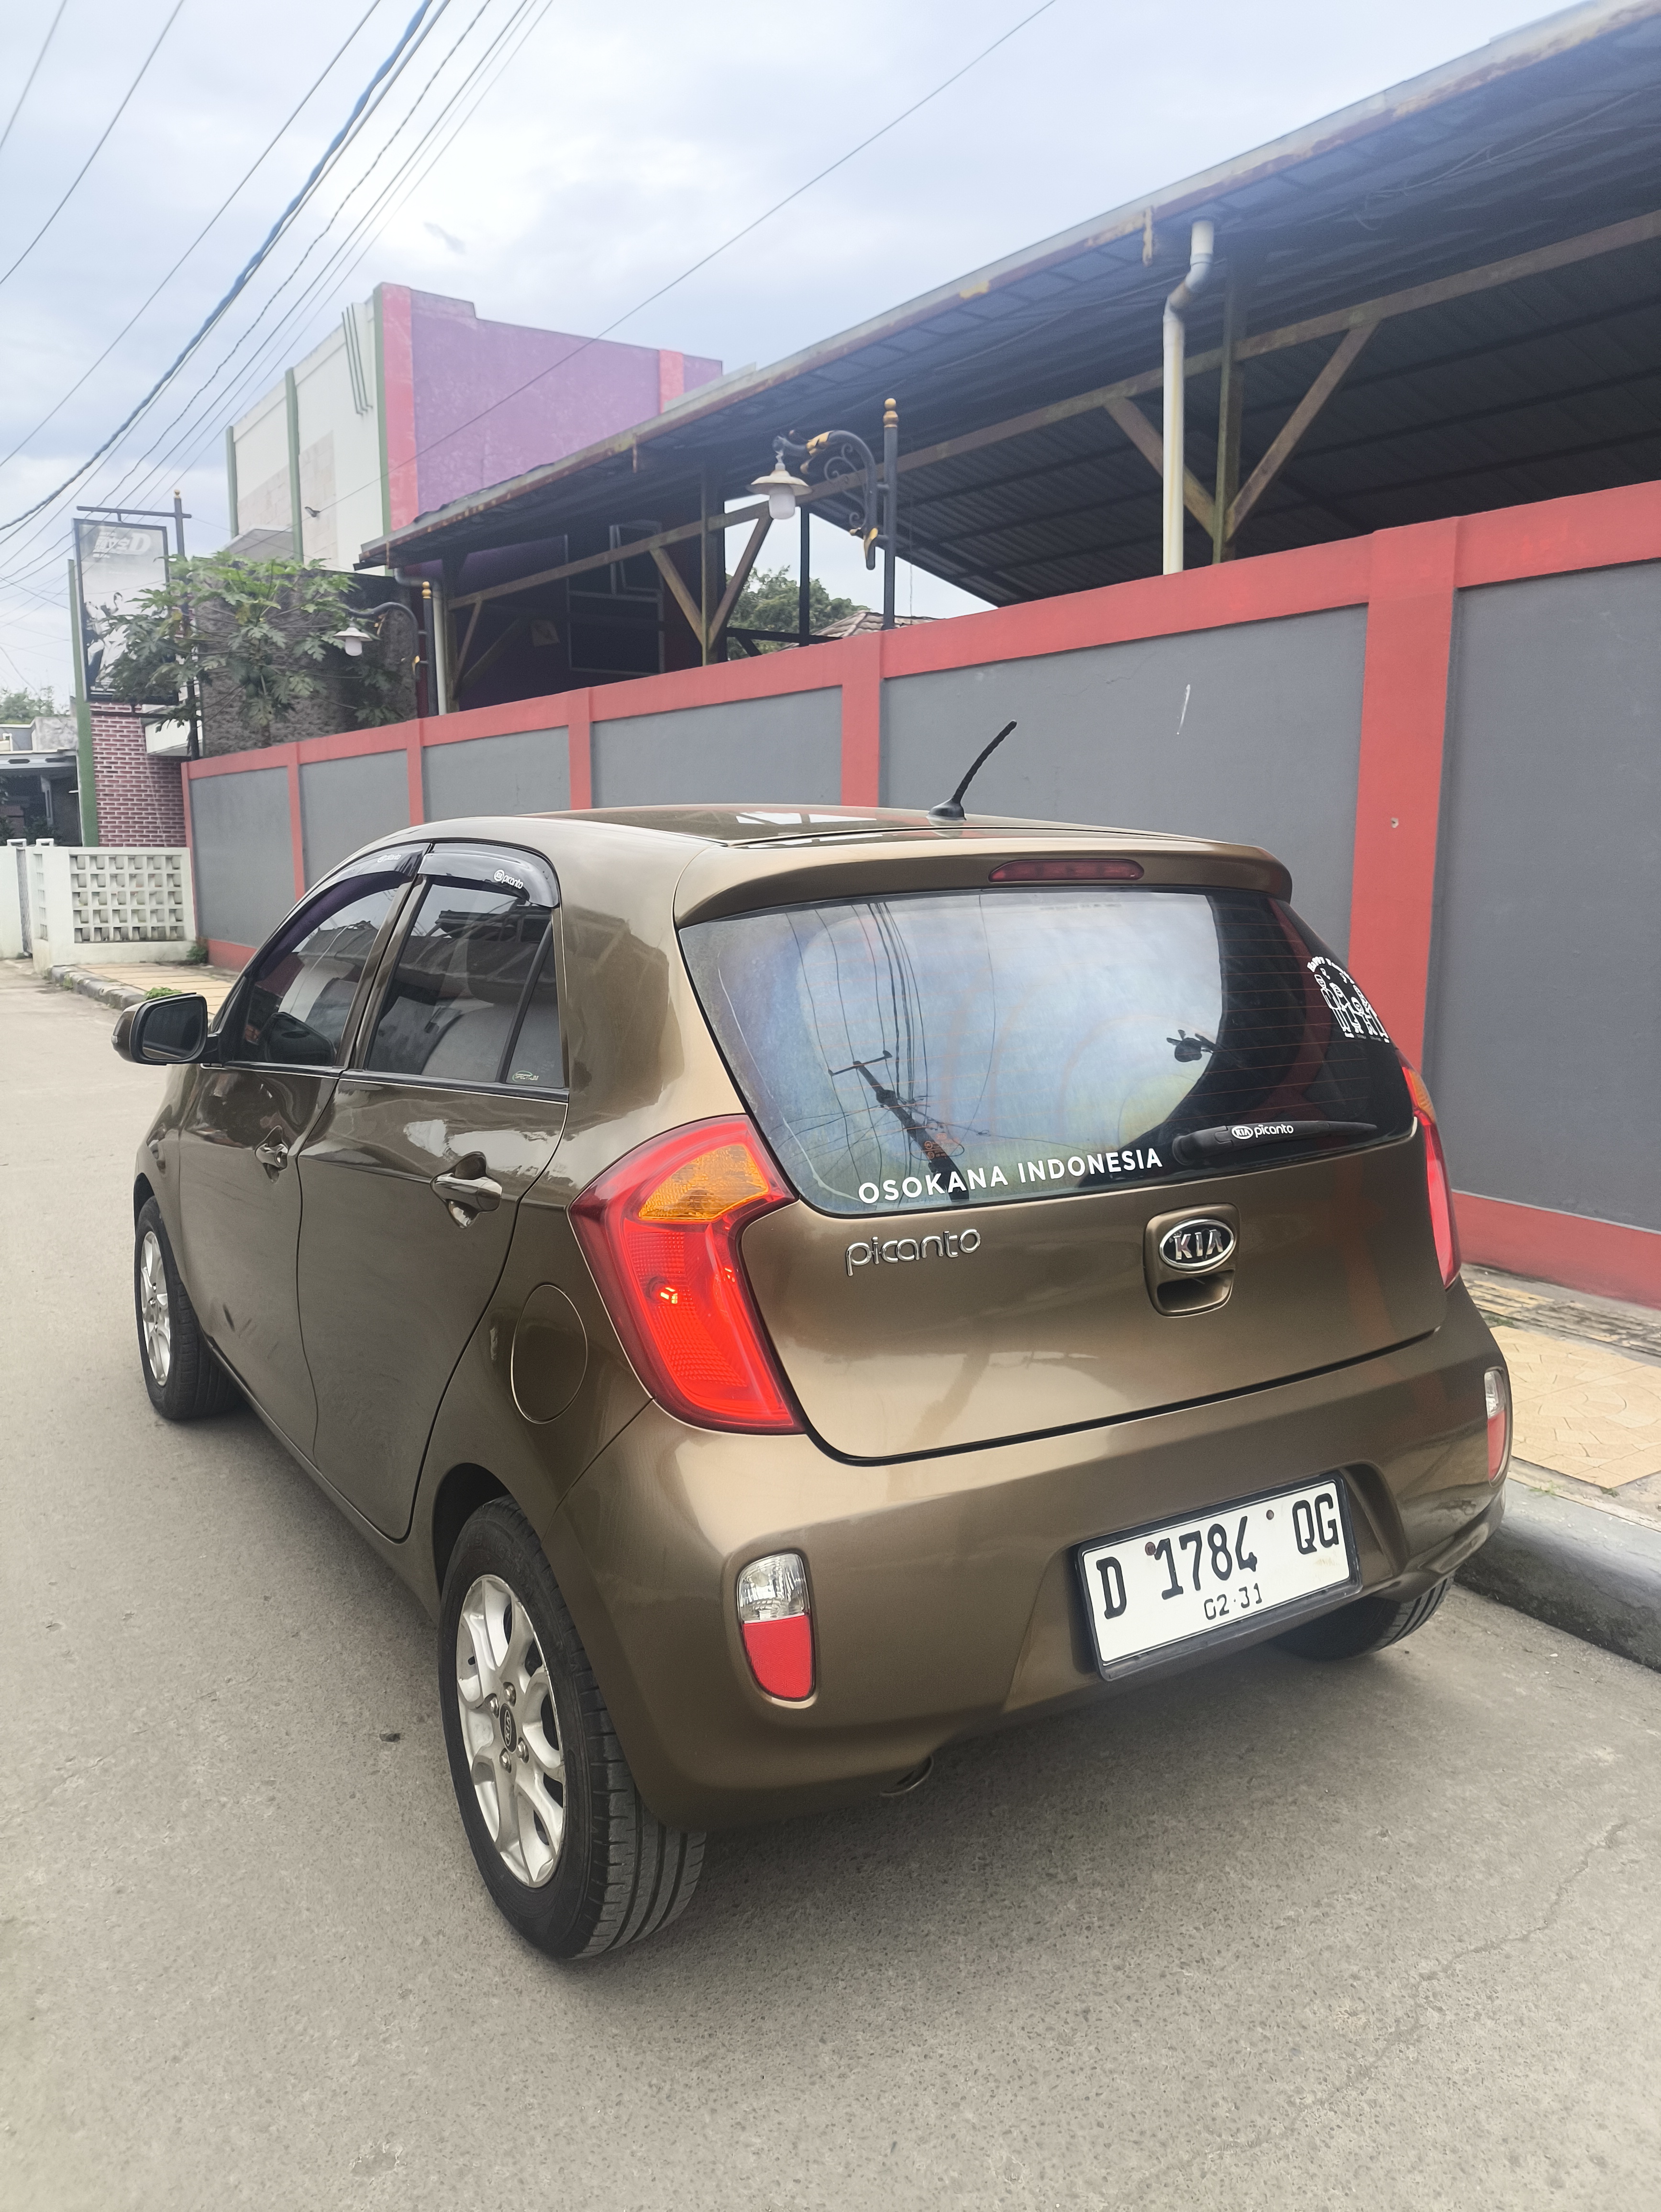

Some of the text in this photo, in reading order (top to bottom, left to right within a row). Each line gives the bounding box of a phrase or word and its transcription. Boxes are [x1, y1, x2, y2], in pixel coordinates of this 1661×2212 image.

[1254, 1124, 1294, 1138] picanto
[858, 1148, 1163, 1204] OSOKANA INDONESIA
[845, 1228, 981, 1277] picanto
[1173, 1229, 1224, 1261] KIA
[1096, 1493, 1340, 1620] D 1784 QG
